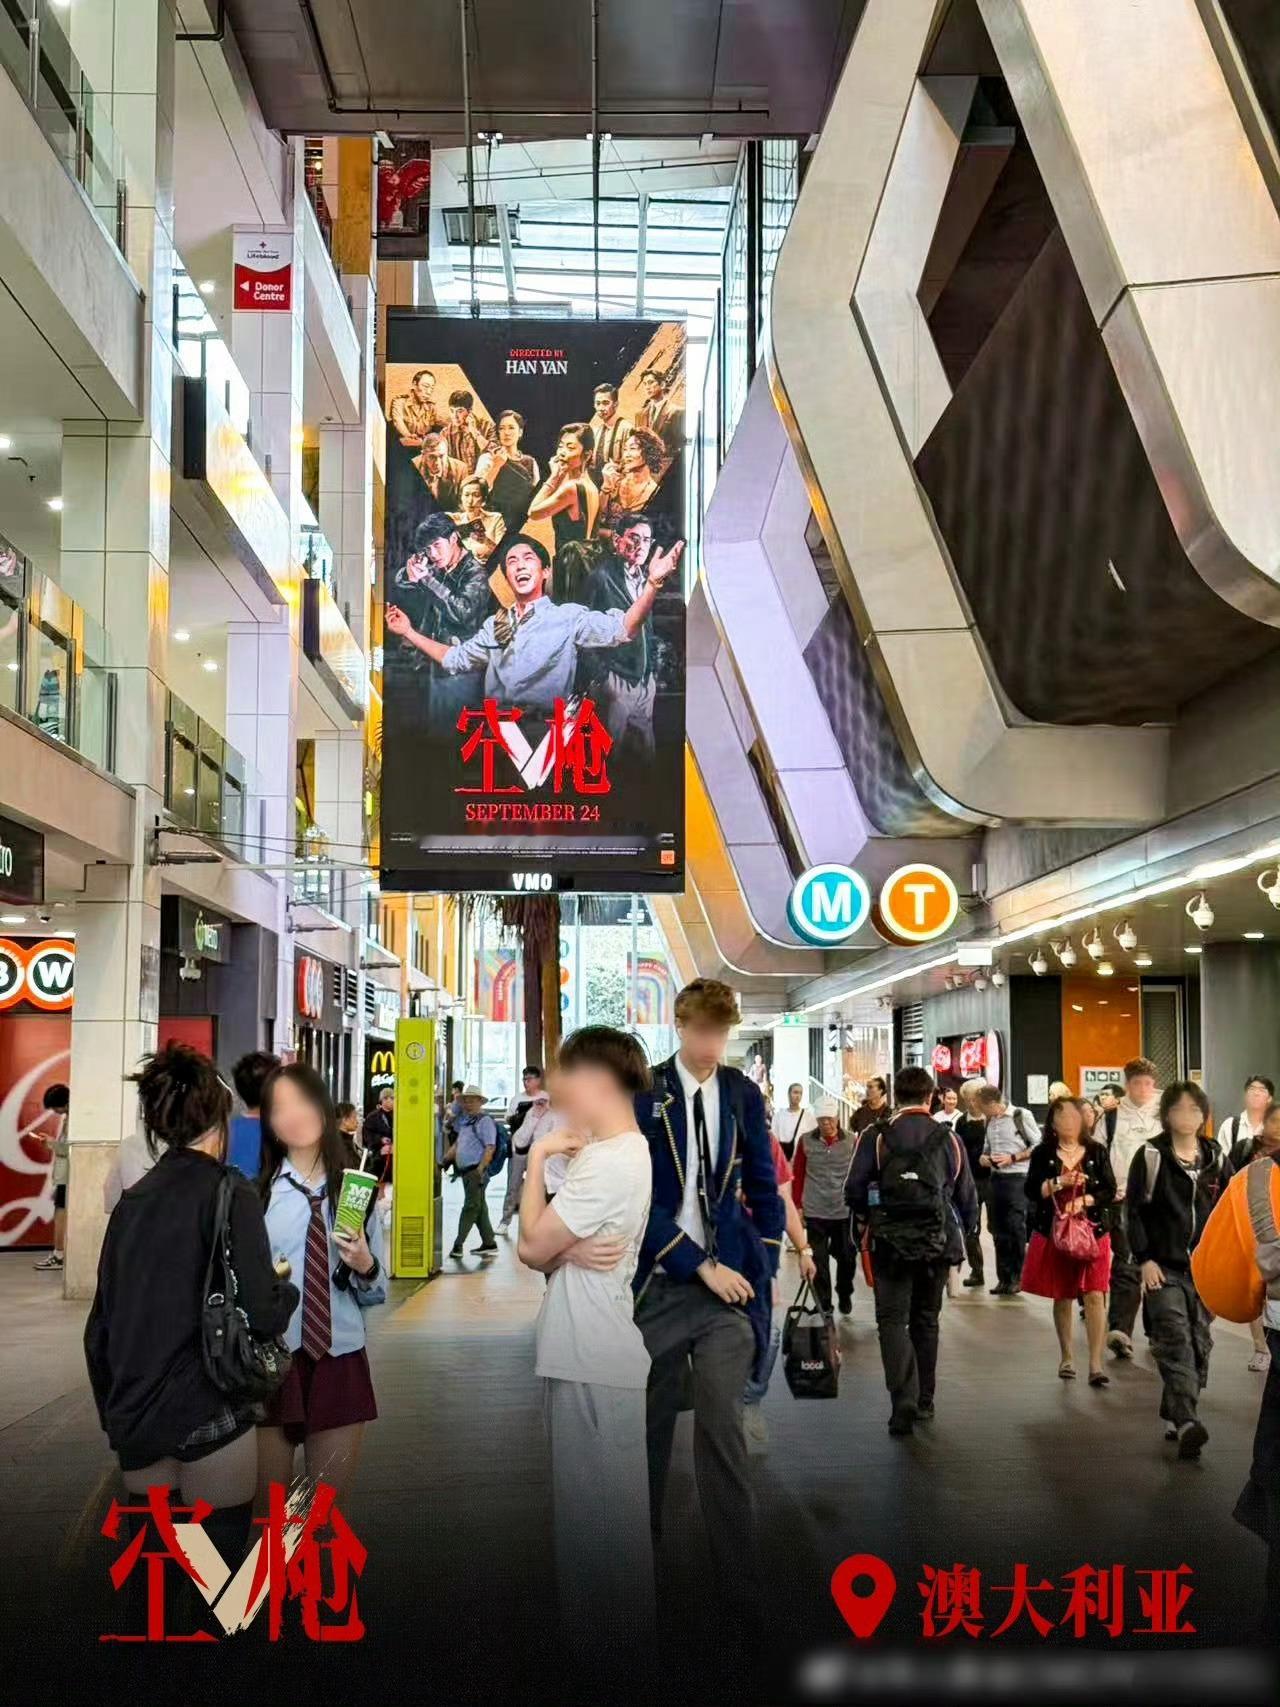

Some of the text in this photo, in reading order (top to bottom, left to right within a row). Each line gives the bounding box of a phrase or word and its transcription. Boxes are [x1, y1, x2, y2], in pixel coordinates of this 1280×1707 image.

[255, 281, 284, 292] Donor
[254, 291, 285, 301] Centre
[509, 348, 553, 357] DIRECTED
[505, 360, 568, 375] HAN YAN
[465, 803, 601, 821] SEPTEMBER 24
[511, 873, 553, 890] VMO
[811, 881, 852, 923] M
[903, 883, 936, 925] T
